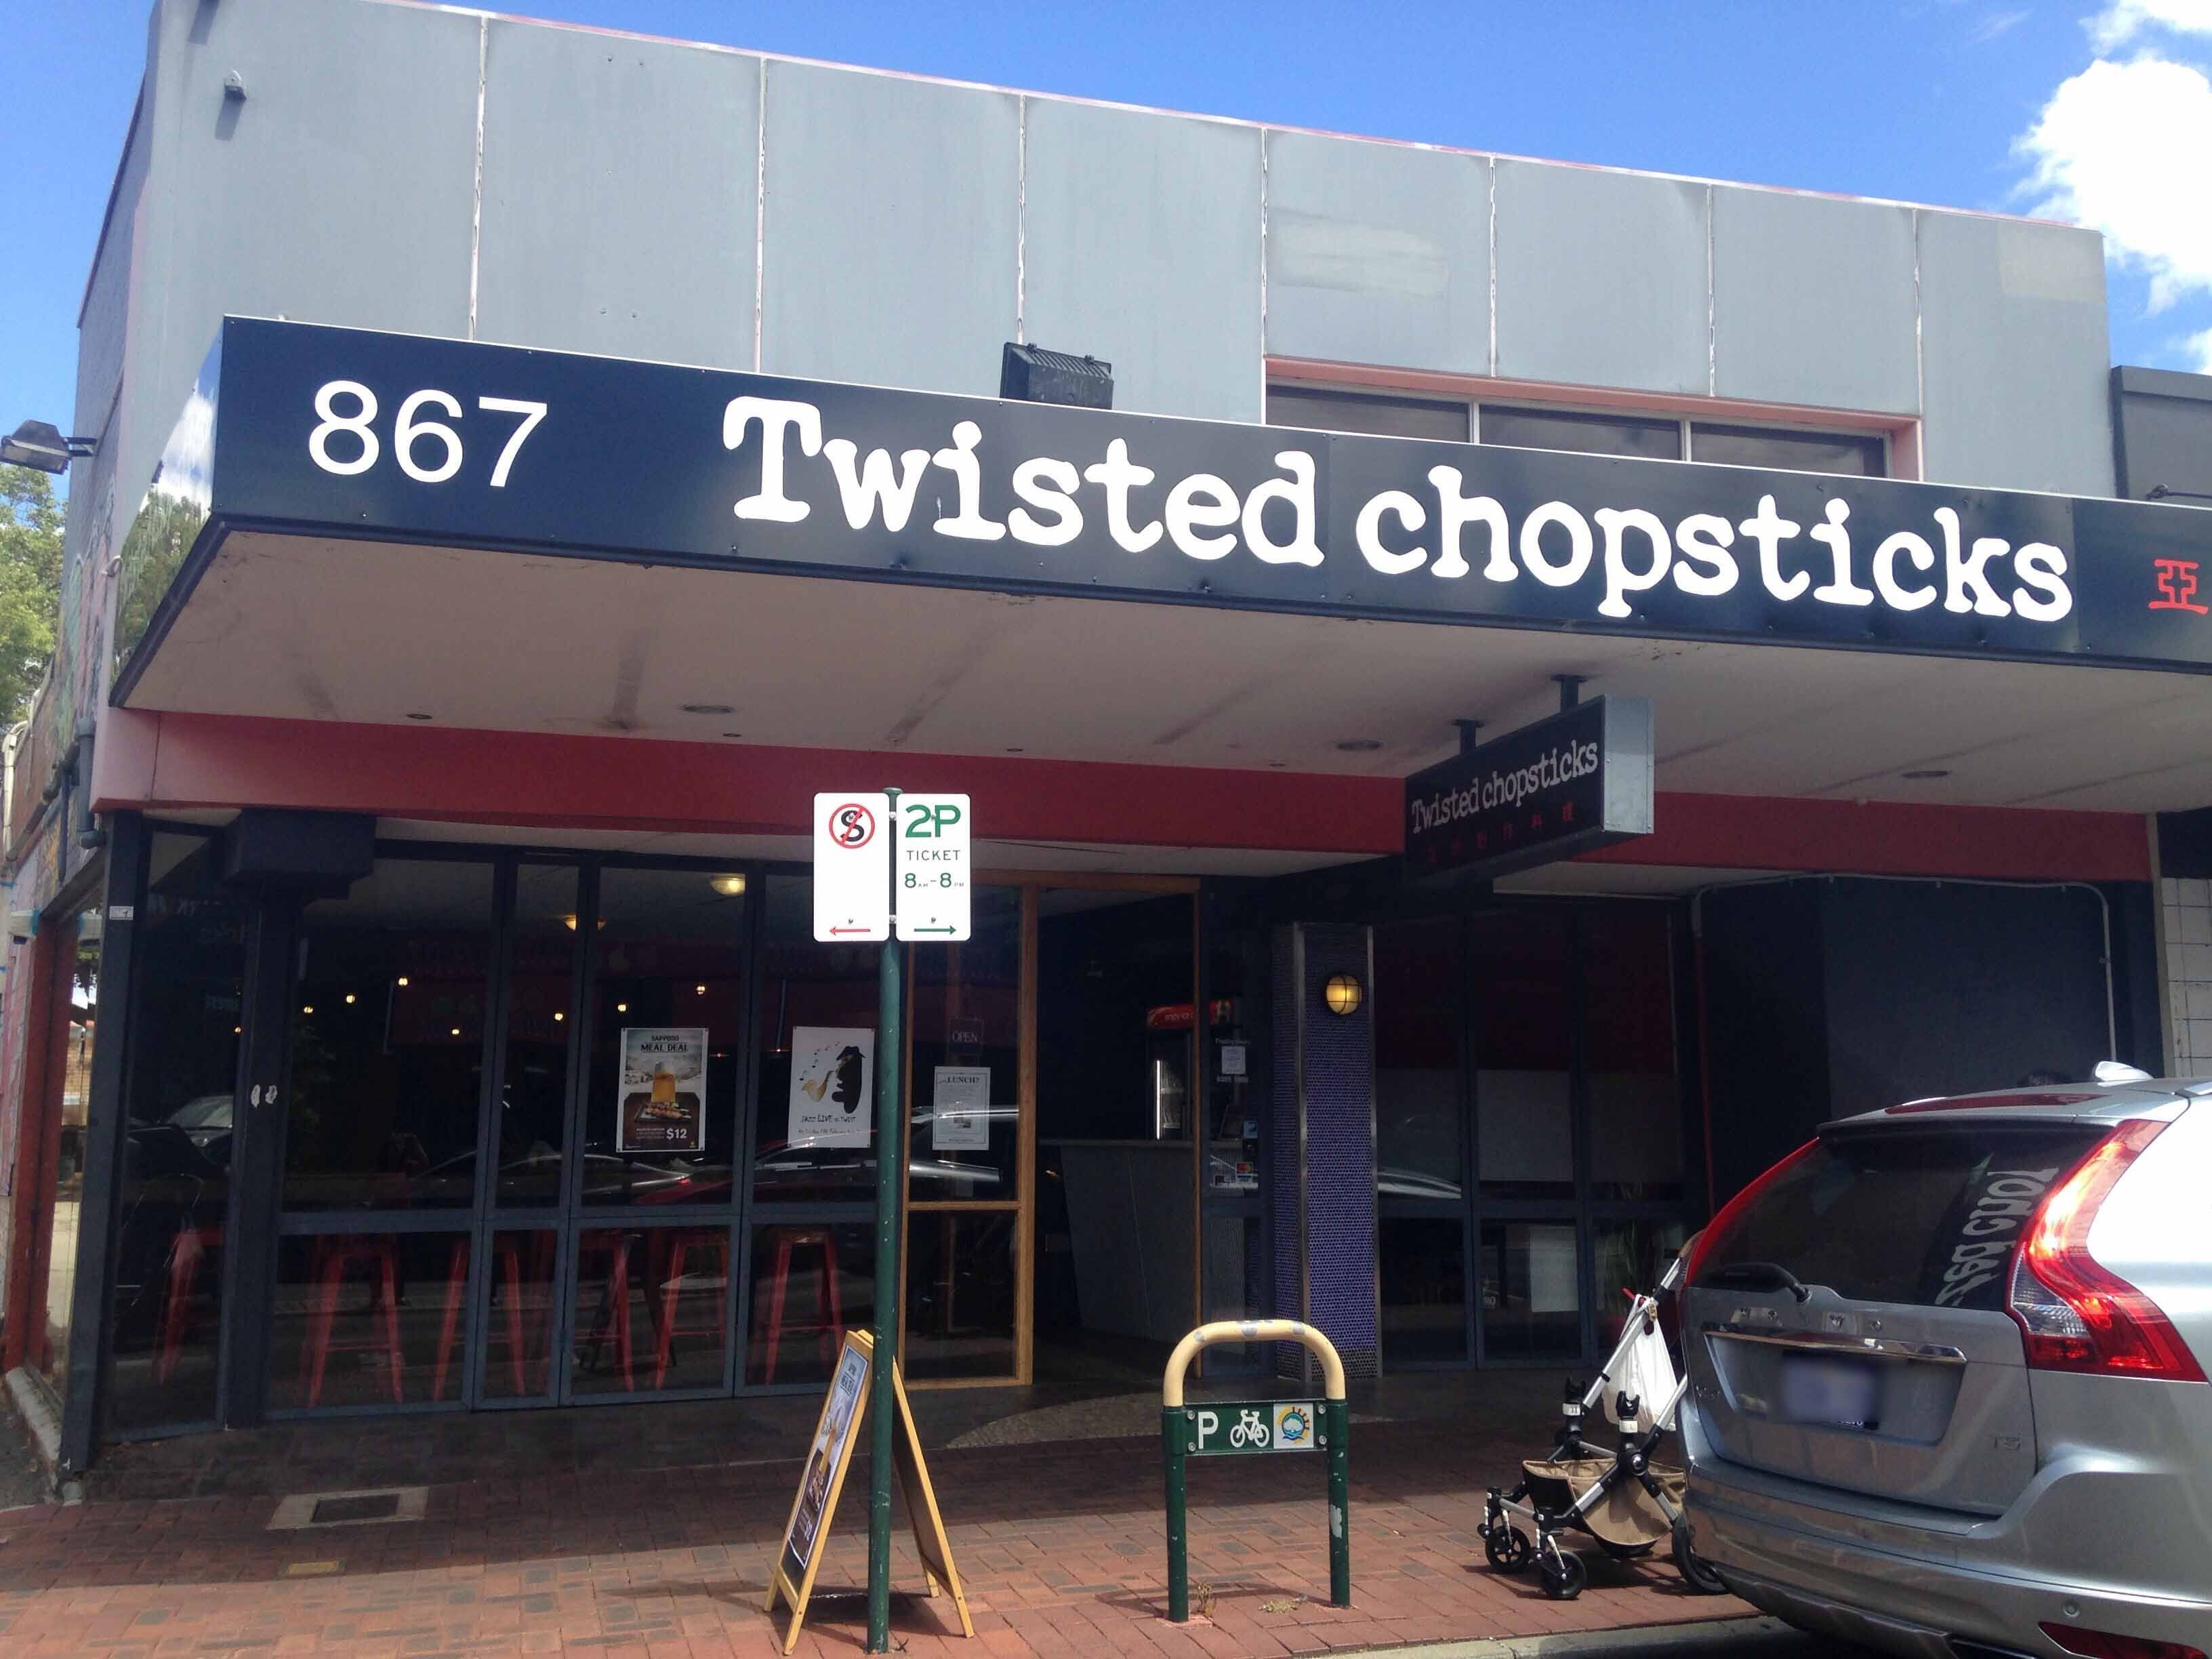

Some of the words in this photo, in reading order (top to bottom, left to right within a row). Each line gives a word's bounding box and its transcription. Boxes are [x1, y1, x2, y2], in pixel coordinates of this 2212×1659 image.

[309, 380, 548, 488] 867
[722, 396, 1325, 567] Twisted
[1355, 465, 2072, 622] chopsticks
[2148, 558, 2209, 615] 亞
[1412, 777, 1479, 834] Twisted
[1482, 739, 1598, 807] chopsticks
[905, 804, 961, 838] 2P
[906, 850, 960, 861] TICKET
[640, 1044, 663, 1052] MEAL
[667, 1044, 689, 1052] DEAL
[666, 1127, 688, 1140] $12
[1197, 1411, 1219, 1450] P
